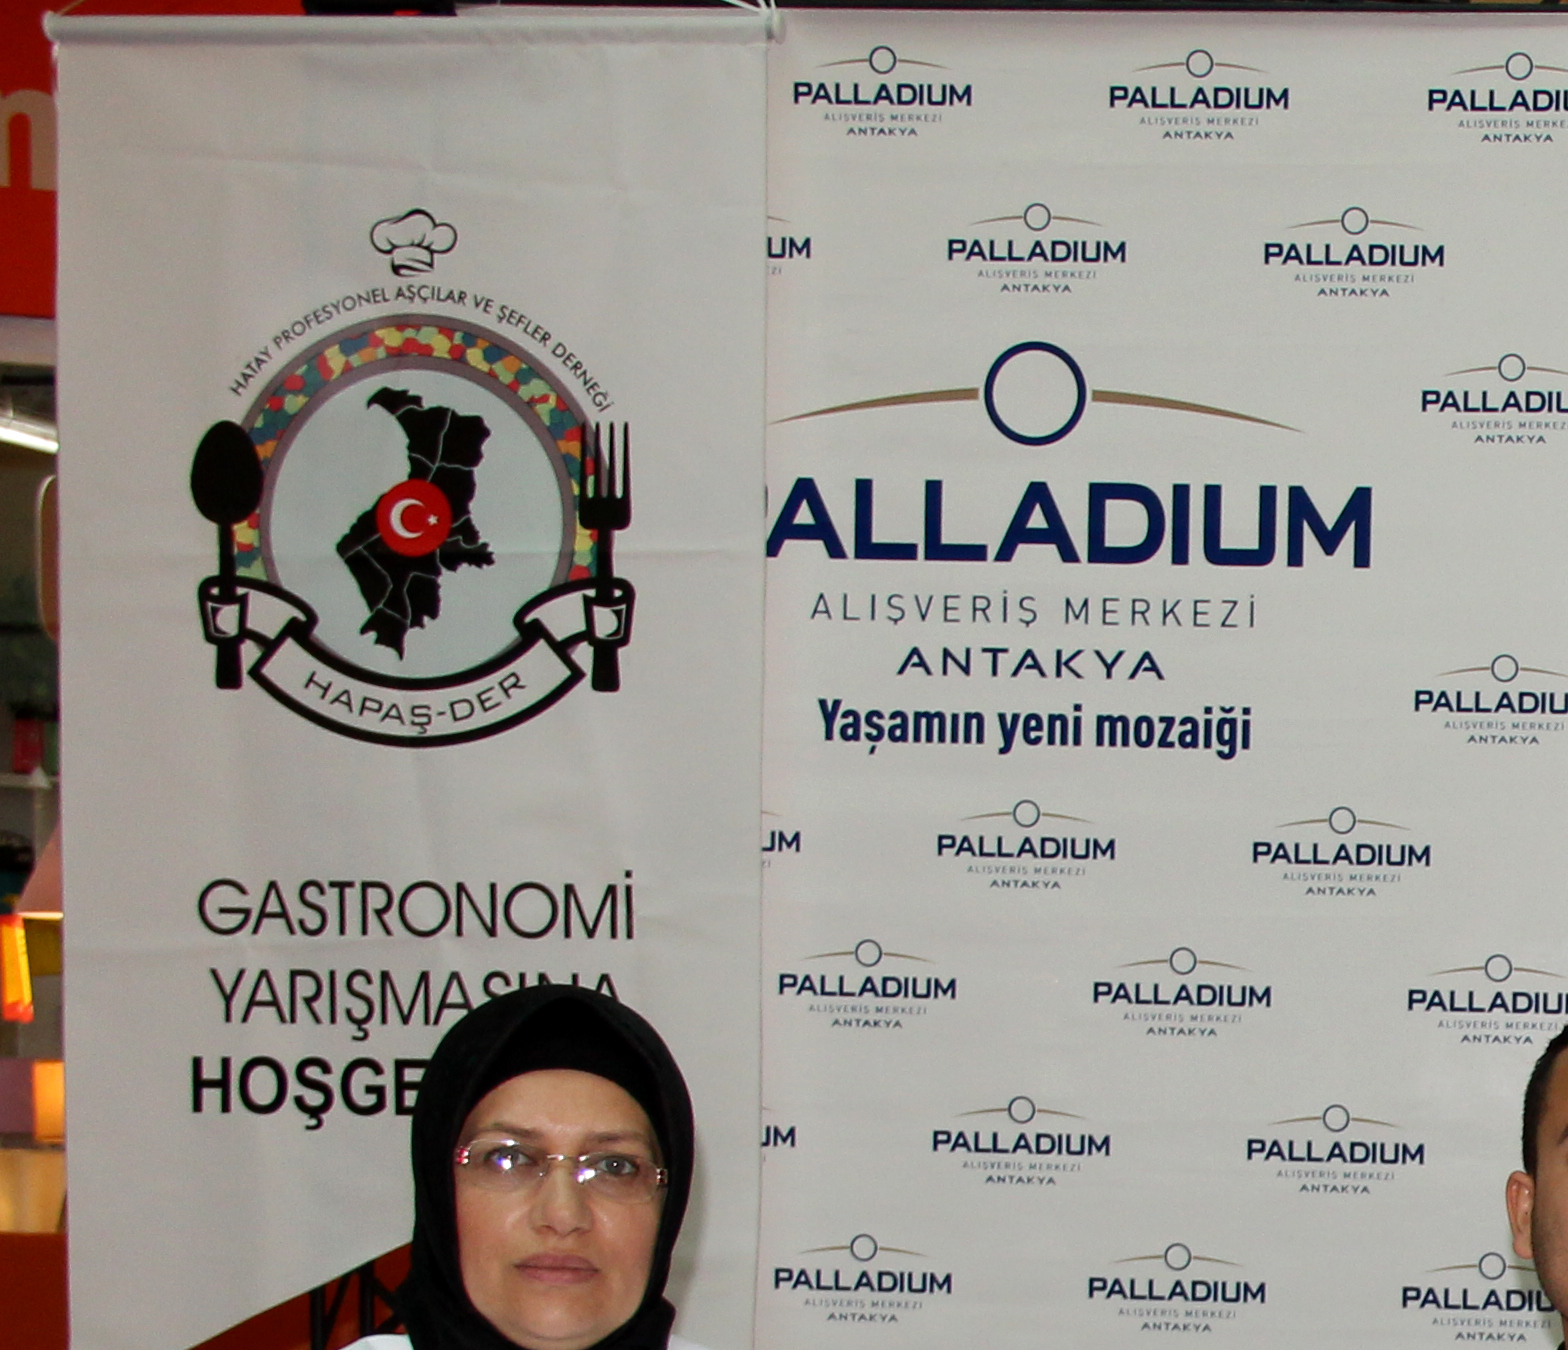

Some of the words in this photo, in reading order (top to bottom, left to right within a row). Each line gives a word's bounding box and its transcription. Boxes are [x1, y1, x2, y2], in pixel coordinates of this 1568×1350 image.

[794, 82, 971, 106] PALLADIUM
[1110, 86, 1288, 109] PALLADIUM
[847, 127, 917, 136] ANTAKYA
[948, 239, 1126, 262] PALLADIUM
[1265, 243, 1444, 266] PALLADIUM
[230, 346, 273, 396] HATAY
[273, 288, 390, 350] PROFESYONEL
[395, 285, 467, 306] AŞÇILAR
[473, 294, 494, 314] VE
[496, 304, 552, 349] ŞEFLER
[551, 342, 617, 413] DERNEĞİ
[765, 477, 1373, 569] ALLADIUM
[811, 590, 1037, 627] ALIŞVERİŞ
[1065, 595, 1254, 627] MERKEZİ
[897, 647, 1164, 680] ANTAKYA
[304, 670, 528, 735] HAPAŞ-DER
[818, 699, 984, 754] Yaşamın
[998, 704, 1082, 755] yeni
[1096, 706, 1251, 760] mozaiği
[1468, 735, 1539, 744] ANTAKYA
[938, 835, 1115, 860] PALLADIUM
[1253, 842, 1430, 866] PALLADIUM
[198, 870, 633, 939] GASTRONOMİ
[779, 974, 956, 999] PALLADIUM
[1094, 982, 1271, 1007] PALLADIUM
[210, 967, 621, 1041] YARIŞMA
[933, 1131, 1110, 1156] PALLADIUM
[1247, 1139, 1424, 1164] PALLADIUM
[775, 1268, 951, 1294] PALLADIUM
[1089, 1277, 1265, 1303] PALLADIUM
[1402, 1286, 1555, 1312] PALLADIU
